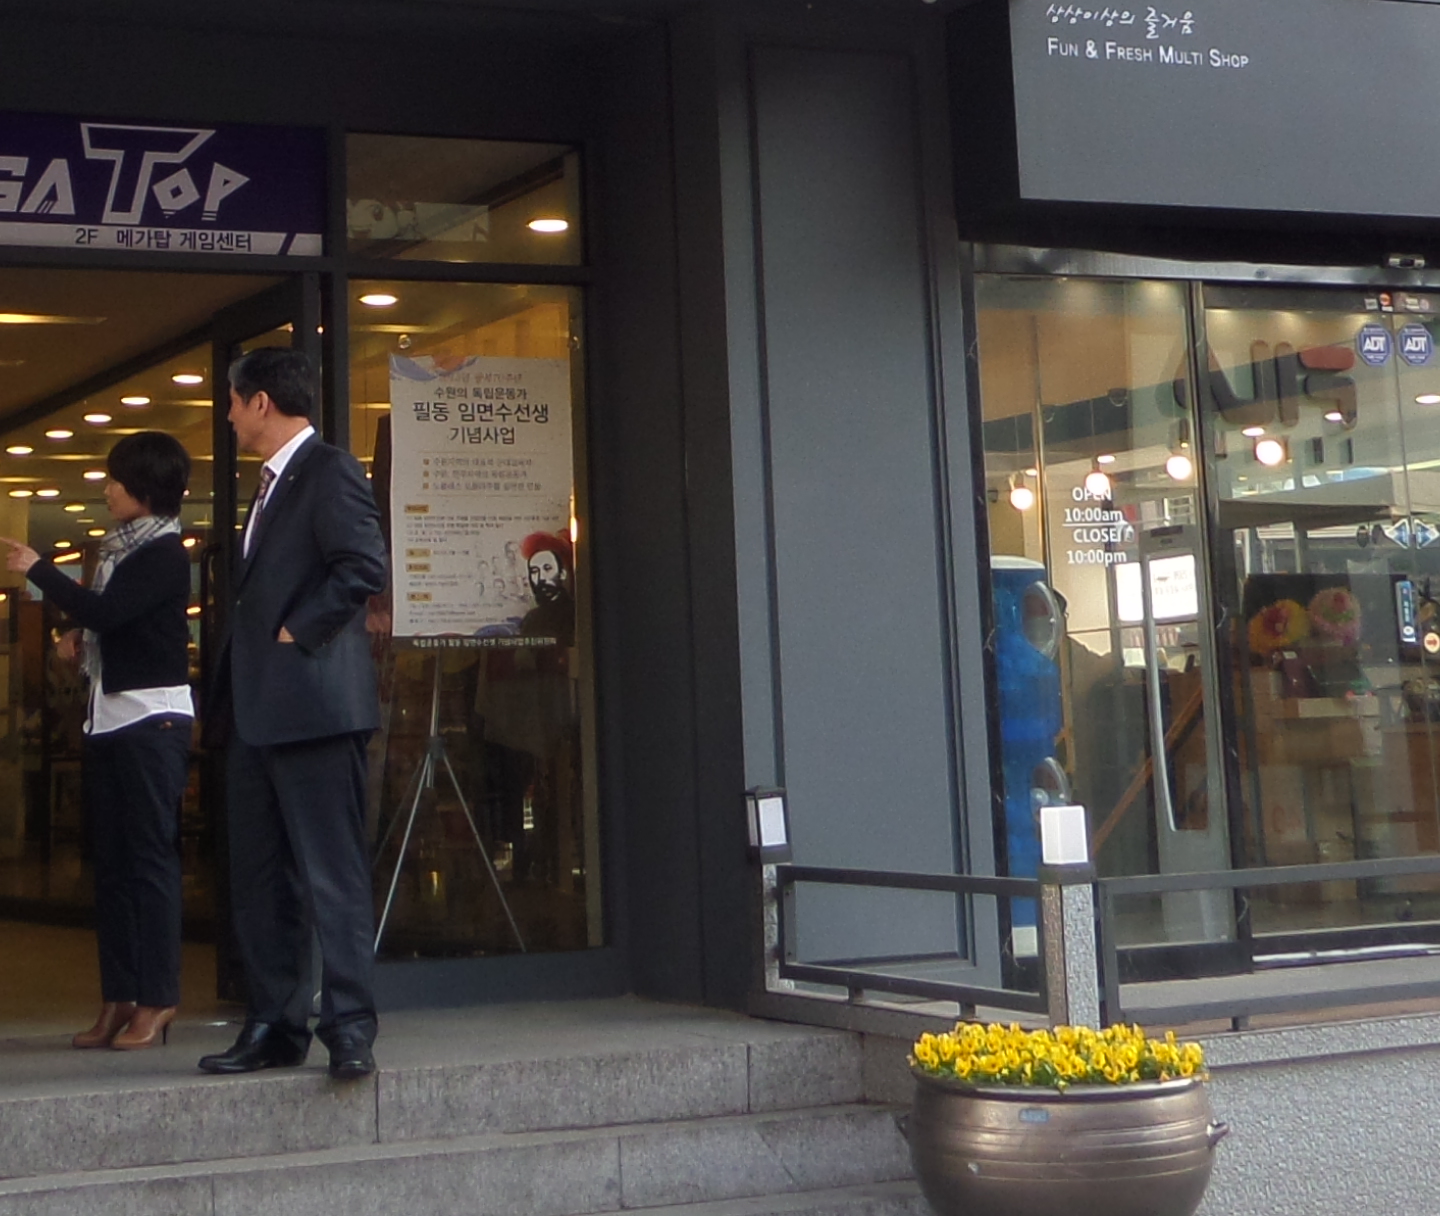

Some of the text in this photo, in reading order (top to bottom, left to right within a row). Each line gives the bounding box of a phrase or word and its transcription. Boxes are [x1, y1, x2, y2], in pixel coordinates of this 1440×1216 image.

[1046, 3, 1195, 39] 상상이상의 즐거움
[1047, 38, 1250, 69] FUN & FRESH MULTI SHOP
[75, 228, 253, 254] 2F 메가탑 게임센터
[1363, 336, 1386, 352] ADT
[1404, 336, 1427, 352] ADT
[434, 386, 527, 400] 수원의 독립운동가
[412, 401, 549, 424] 필동 임면수선생
[449, 427, 516, 445] 기념사업
[1064, 507, 1123, 522] 10:00am
[1066, 549, 1127, 568] 10:00pm
